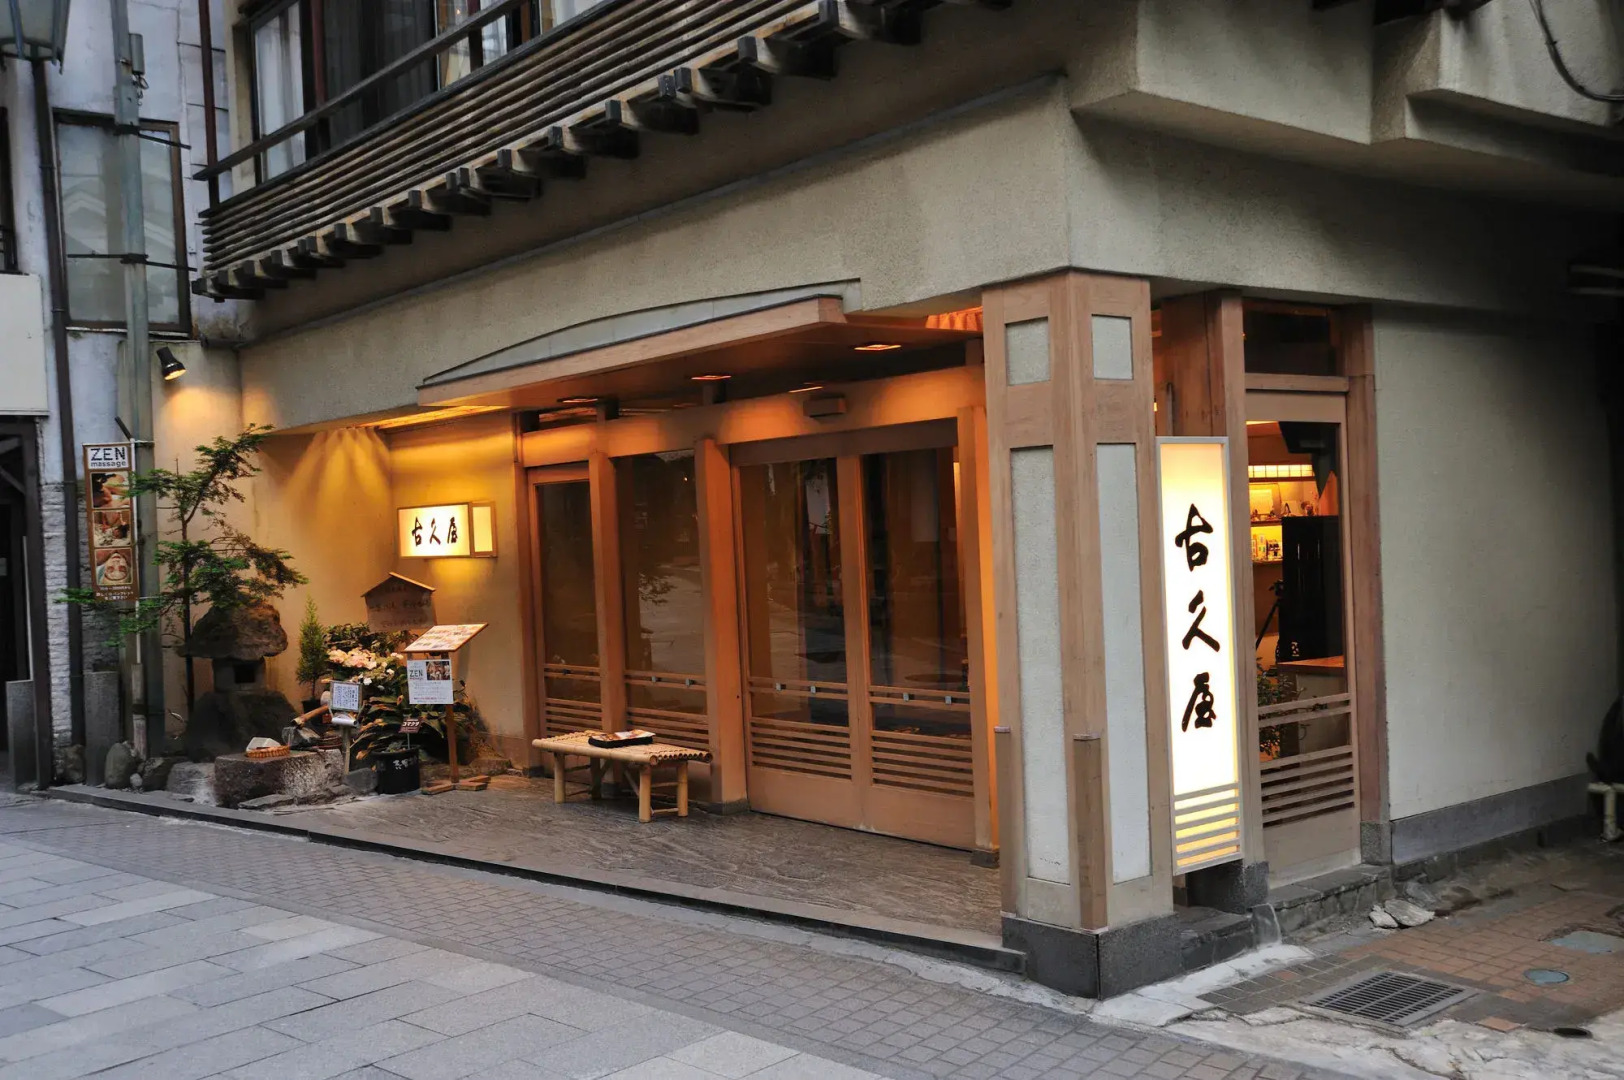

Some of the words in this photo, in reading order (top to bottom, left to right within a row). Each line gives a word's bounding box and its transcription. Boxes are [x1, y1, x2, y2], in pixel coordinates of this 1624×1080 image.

[90, 447, 126, 461] ZEN
[411, 516, 458, 547] 古久屋
[1174, 502, 1221, 733] 古久屋
[409, 669, 424, 678] ZEN
